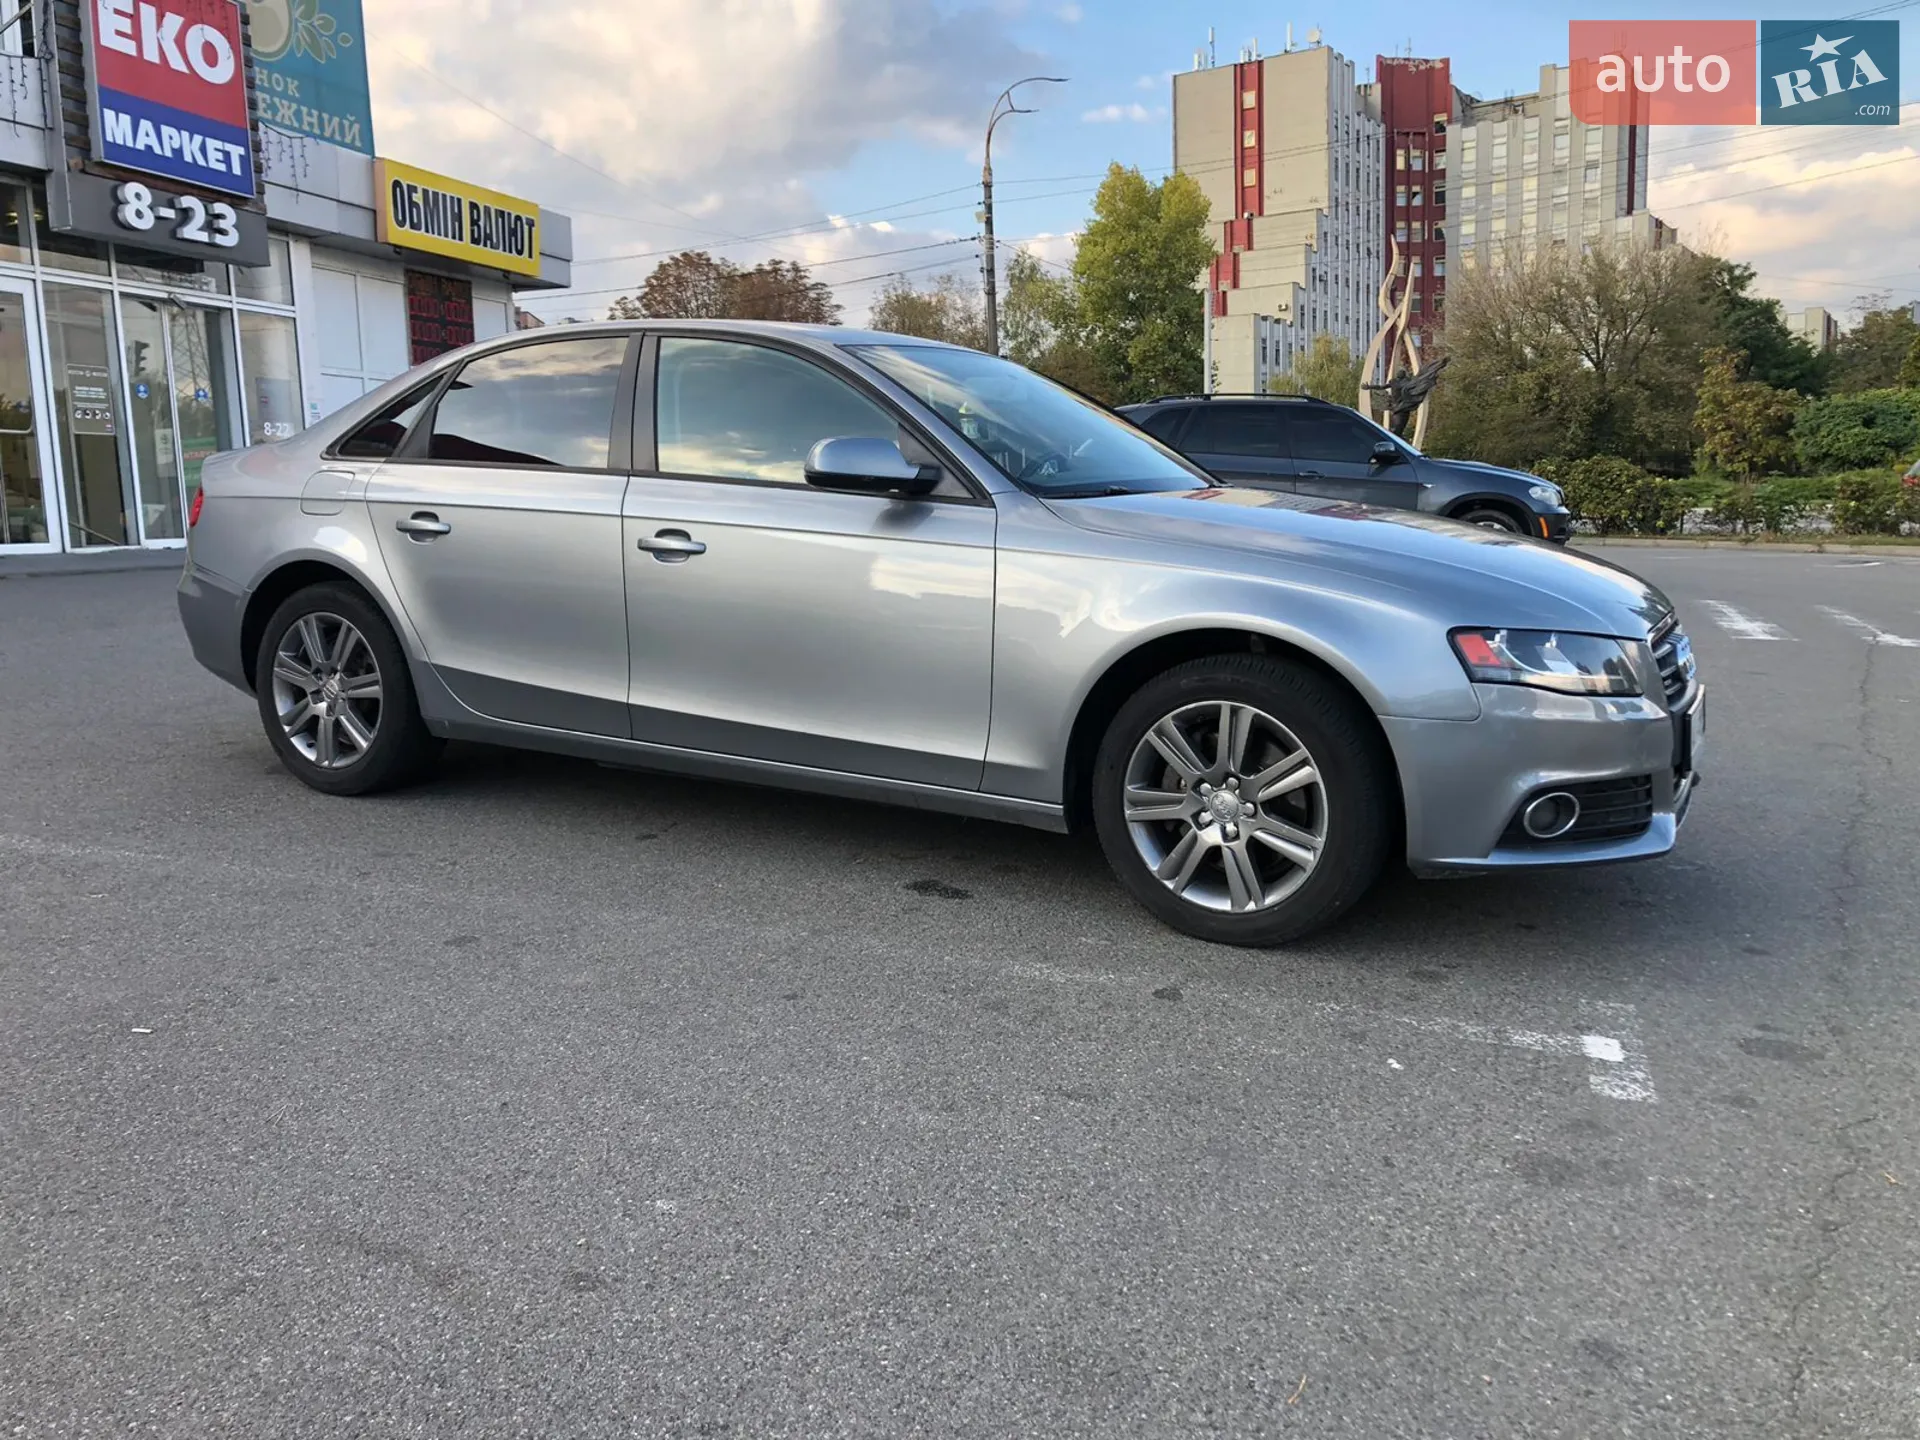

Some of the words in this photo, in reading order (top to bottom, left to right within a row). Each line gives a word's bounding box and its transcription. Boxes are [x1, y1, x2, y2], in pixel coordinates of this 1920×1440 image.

[97, 0, 235, 84] ЕКО
[103, 107, 245, 176] МАРКЕТ
[117, 181, 239, 247] 8-23
[391, 179, 464, 242] ОБМІН
[468, 200, 536, 260] ВАЛЮТ
